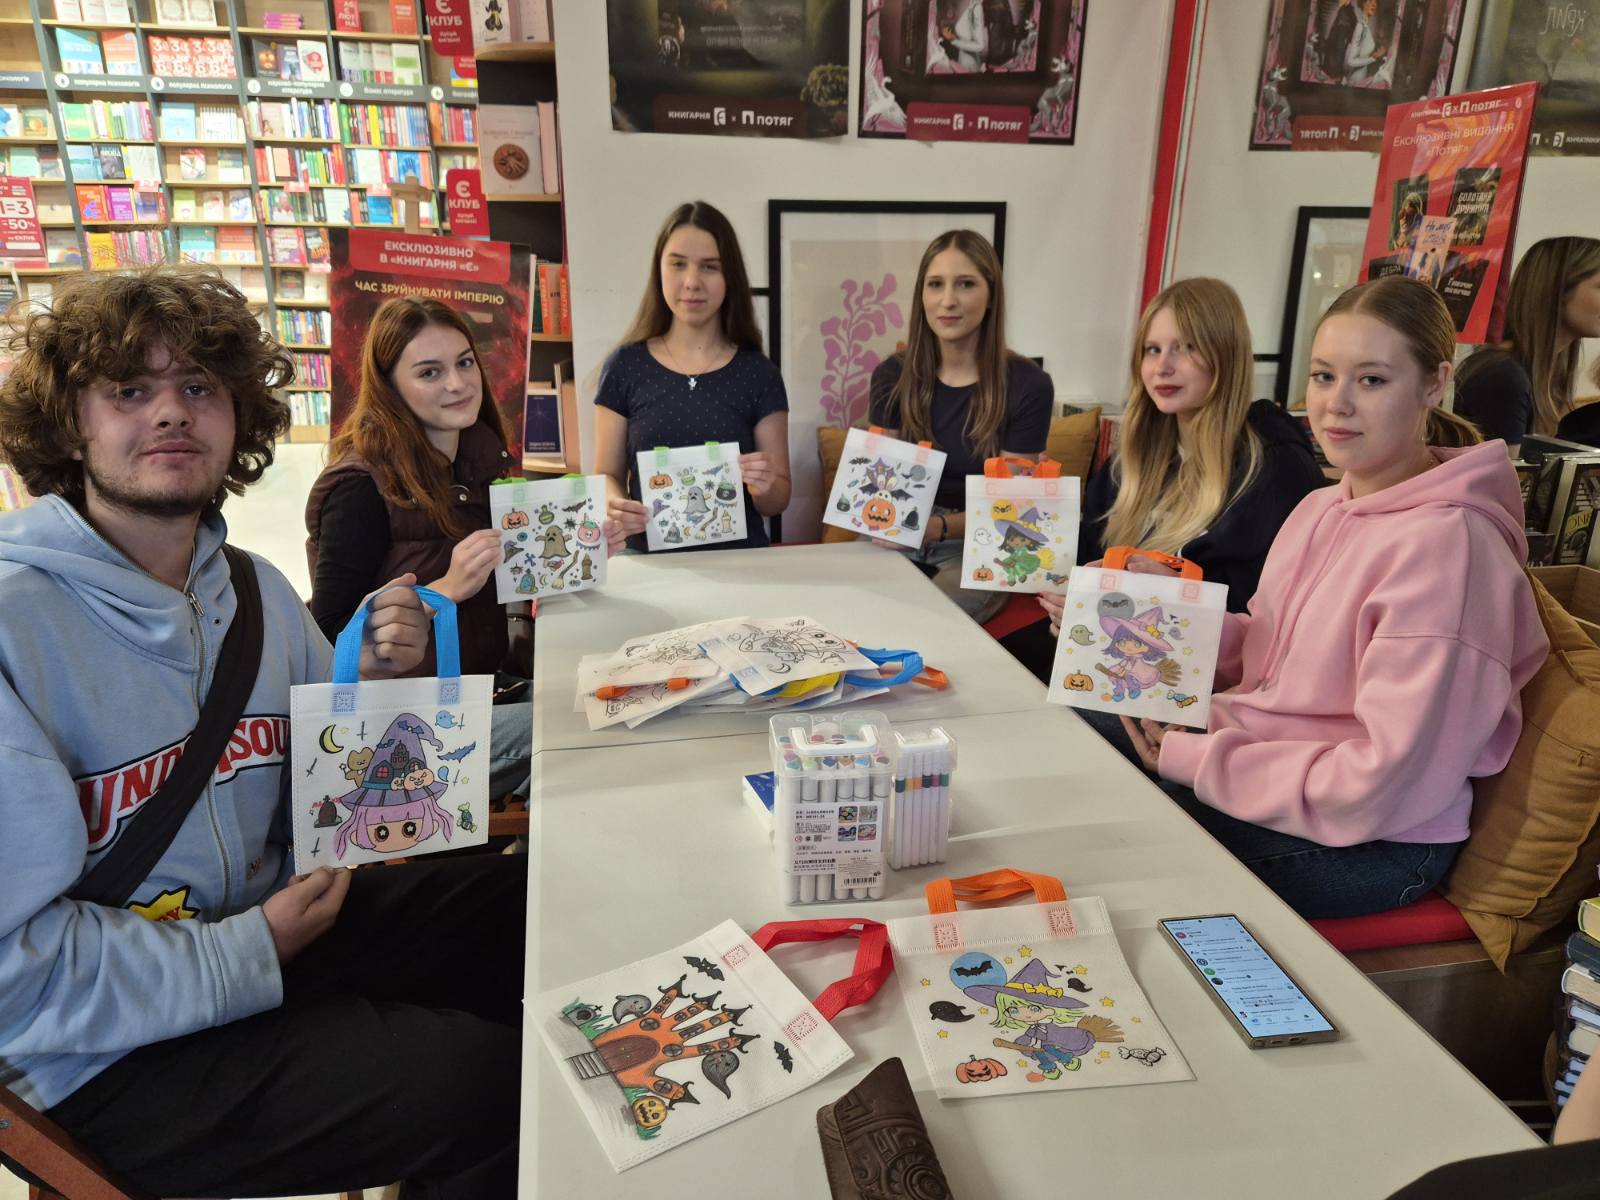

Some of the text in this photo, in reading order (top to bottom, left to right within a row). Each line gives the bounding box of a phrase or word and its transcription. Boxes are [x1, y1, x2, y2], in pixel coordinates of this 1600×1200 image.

[430, 15, 463, 27] КЛУБ
[668, 110, 711, 120] КНИГАРНЯ
[449, 199, 481, 209] КЛУБ
[384, 240, 474, 258] ЕКСКЛЮЗИВНО
[379, 253, 388, 264] В
[390, 255, 457, 270] «КНИГАРНЯ
[355, 280, 505, 305] ЧАС ЗРУЙНУВАТИ ІМПЕРІЮ
